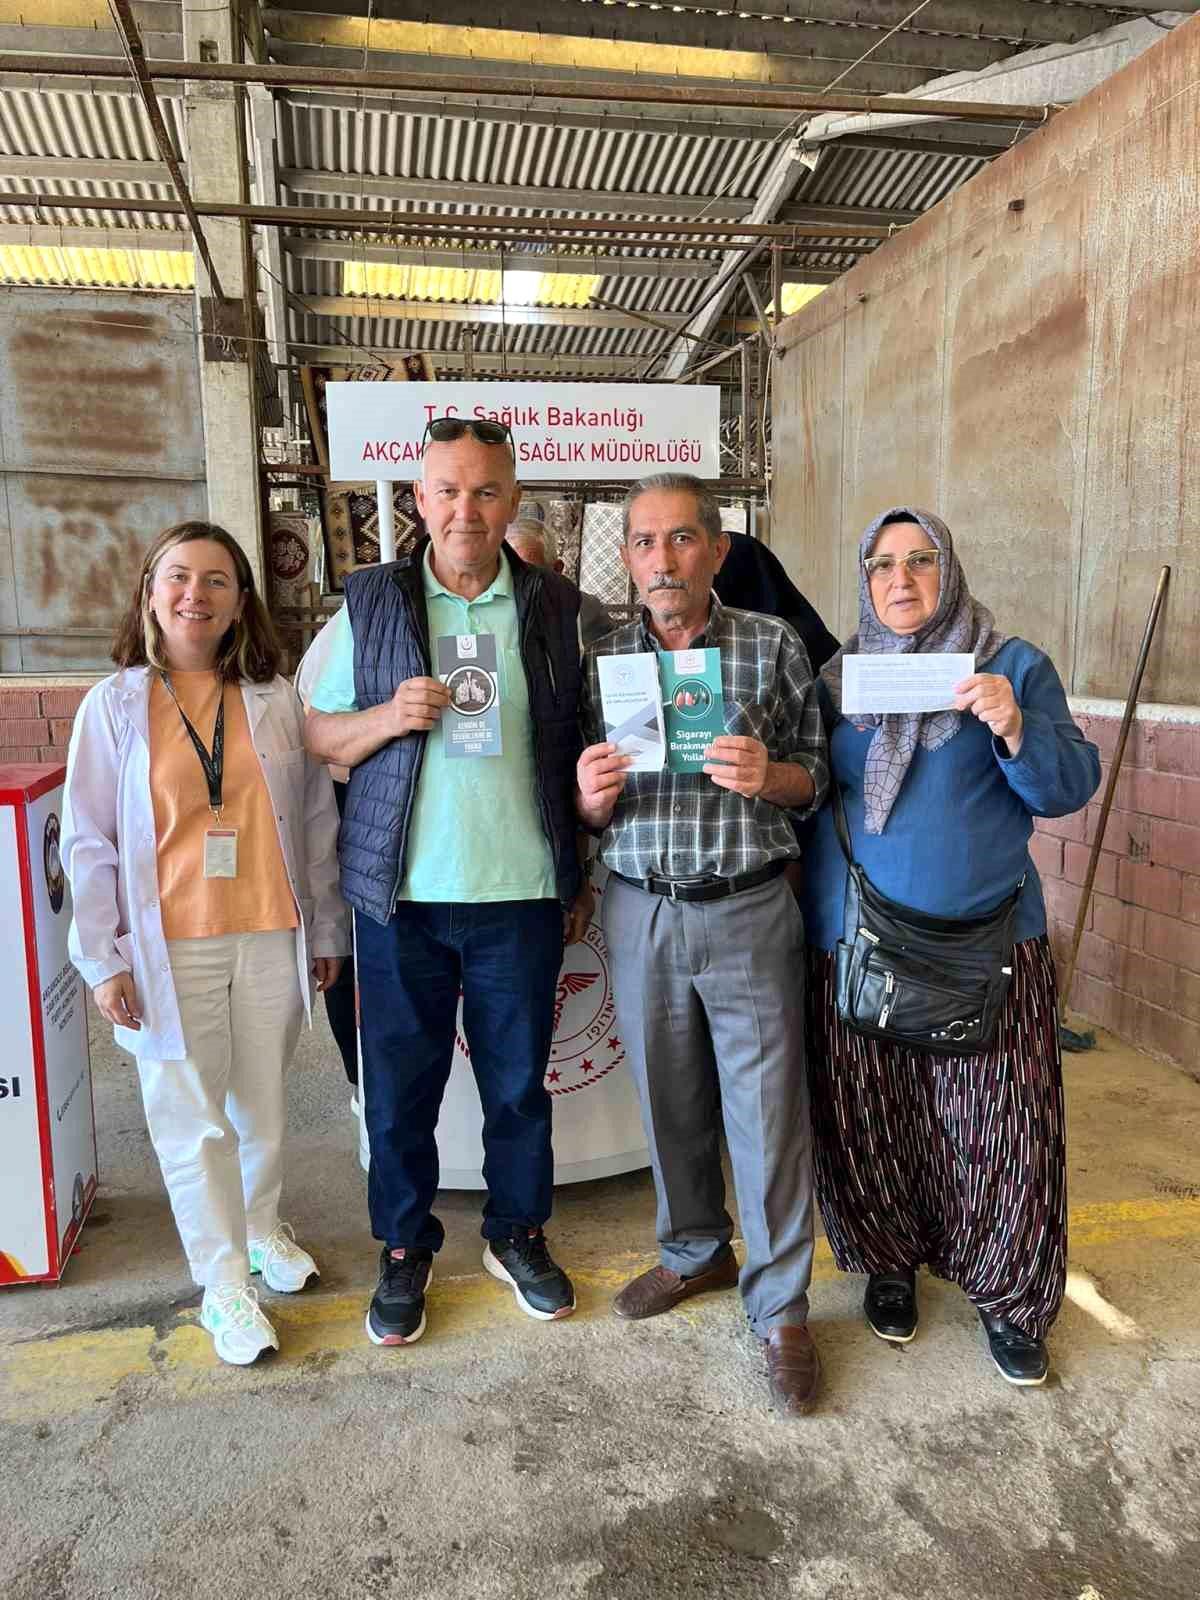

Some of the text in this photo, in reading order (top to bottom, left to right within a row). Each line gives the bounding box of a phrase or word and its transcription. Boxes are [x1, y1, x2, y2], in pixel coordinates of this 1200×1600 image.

[424, 405, 644, 432] TC Sağlık Bakanlığı
[363, 437, 702, 464] AKÇAK SAĞLIK MÜDÜRLÜĞÜ
